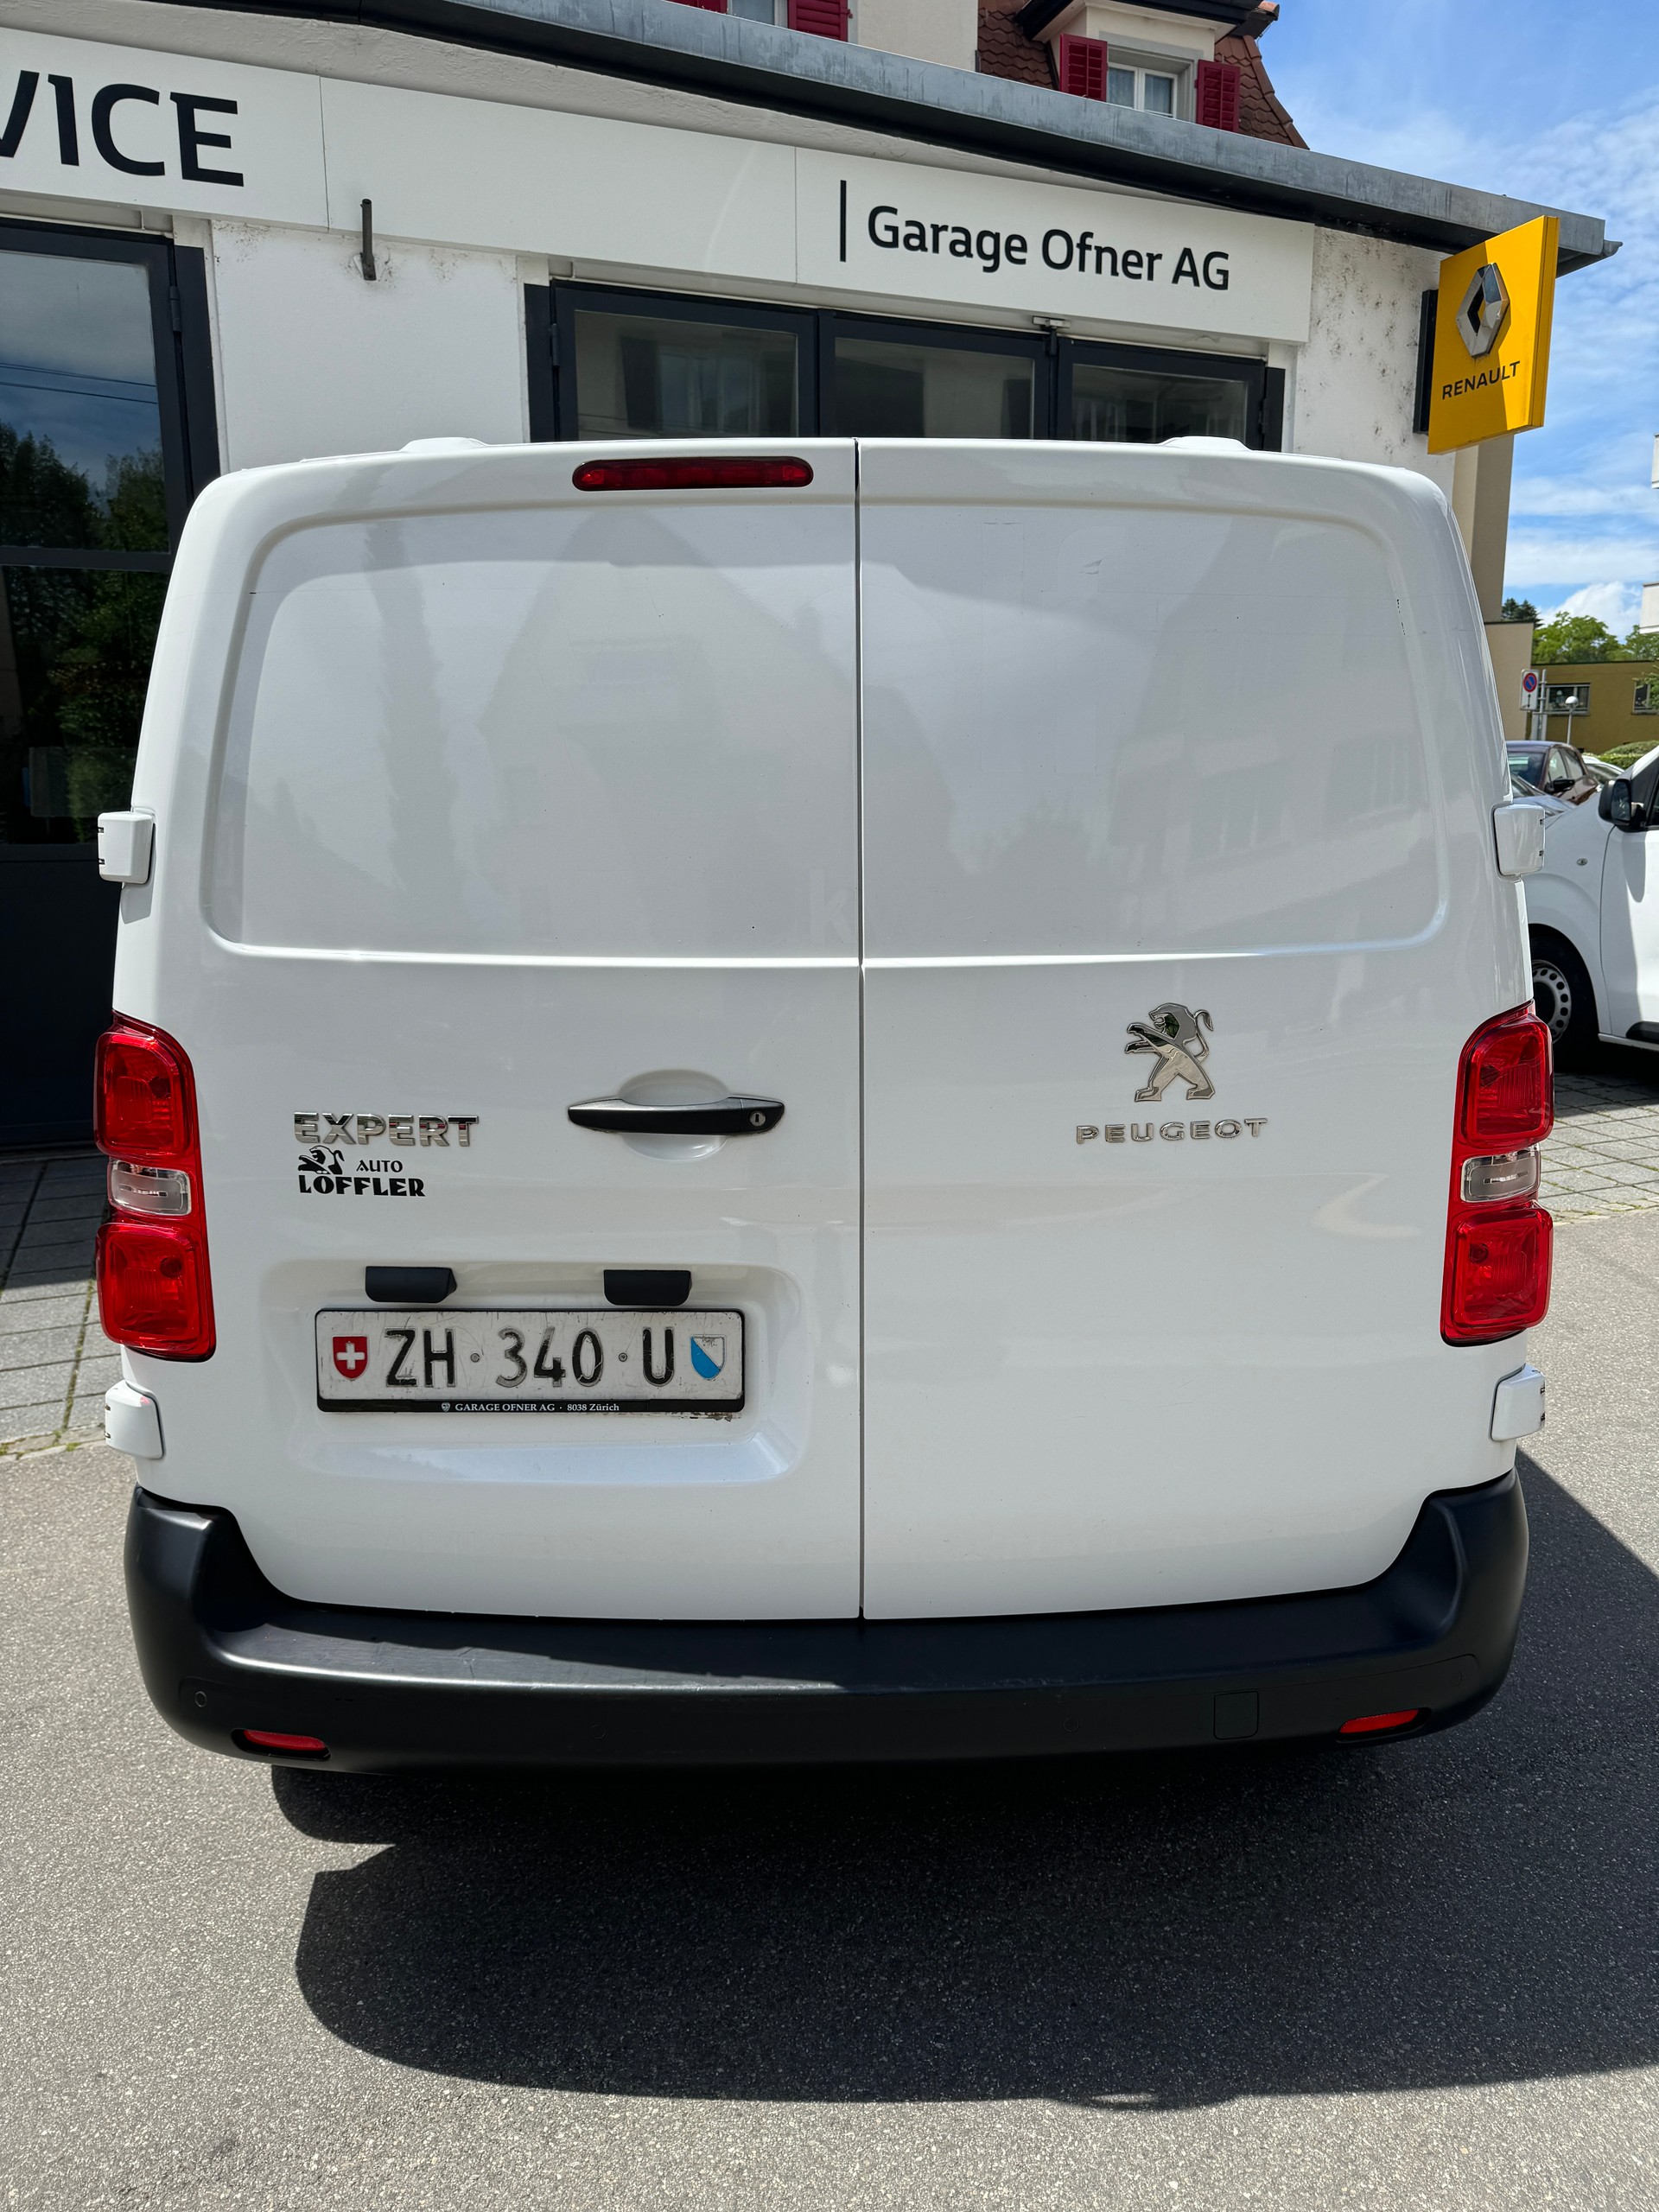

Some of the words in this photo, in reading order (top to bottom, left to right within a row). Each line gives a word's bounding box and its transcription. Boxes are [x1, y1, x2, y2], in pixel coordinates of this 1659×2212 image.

[868, 205, 1028, 273] Garage
[1041, 228, 1163, 282] Ofner
[1171, 247, 1230, 291] AG
[1441, 360, 1521, 400] RENAULT
[293, 1111, 480, 1147] EXPERT
[1076, 1117, 1268, 1145] PEUGEOT
[356, 1159, 404, 1173] AUTO
[298, 1174, 426, 1197] LOFFLER
[385, 1326, 456, 1388] ZH
[495, 1326, 602, 1388] 340
[642, 1326, 675, 1387] U
[454, 1403, 500, 1412] GARAGE
[501, 1403, 538, 1412] OFNER
[539, 1403, 556, 1412] AG
[566, 1403, 588, 1412] 8038
[588, 1402, 620, 1412] Zürich
